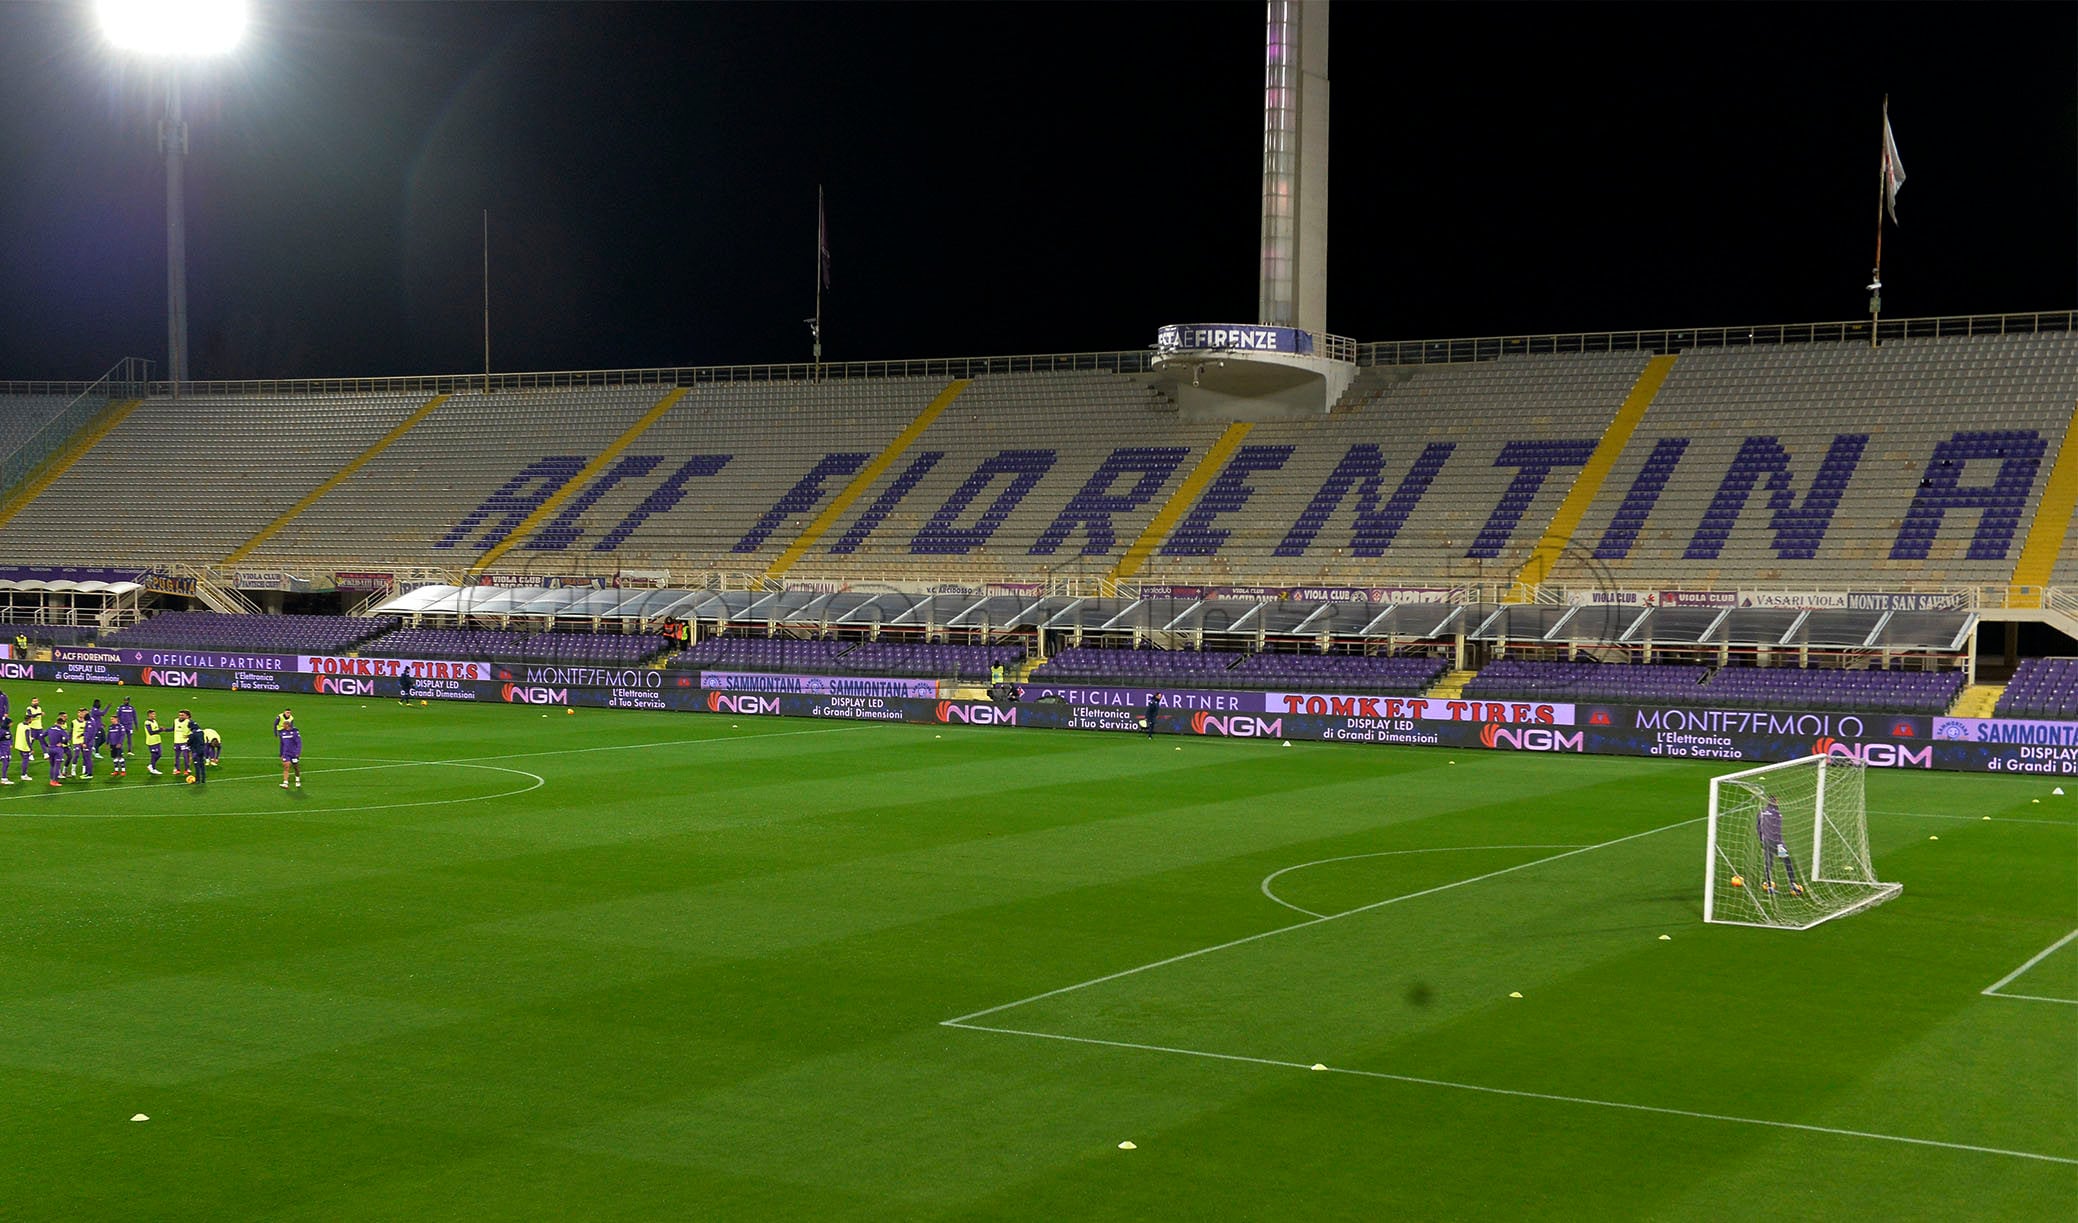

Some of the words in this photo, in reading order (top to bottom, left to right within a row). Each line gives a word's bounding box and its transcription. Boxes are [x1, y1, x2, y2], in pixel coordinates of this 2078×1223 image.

[433, 455, 734, 551] ACF
[731, 429, 2048, 558] FIORENTINA
[493, 576, 517, 584] VIOLA
[519, 577, 541, 585] CLUB
[1304, 590, 1329, 600] VIOLA
[1331, 591, 1350, 601] CLUB
[1592, 592, 1615, 603] VIOLA
[1616, 593, 1637, 604] CLUB
[1679, 593, 1707, 602] VIOLA
[1709, 594, 1735, 602] CLUB
[1756, 594, 1804, 606] VASARI
[1806, 595, 1845, 607] VIOLA
[1849, 594, 1889, 610] MONTE
[1891, 595, 1915, 611] SAN
[62, 652, 76, 661] ACF
[76, 653, 121, 663] FIORENTINA
[153, 654, 214, 668] OFFICIAL
[220, 656, 282, 670] PARTNER
[68, 664, 94, 673] DISPLAY
[95, 665, 106, 674] LED
[309, 657, 400, 676] TOMKET
[411, 662, 479, 680] TIRES
[55, 672, 62, 680] di
[63, 672, 85, 682] Grandi
[86, 673, 120, 682] Dimensioni
[149, 671, 198, 687] NGM
[415, 679, 444, 689] DISPLAY
[446, 681, 459, 689] LED
[241, 681, 253, 690] Tuo
[253, 681, 280, 690] Servizio
[322, 679, 374, 696] NGM
[726, 676, 801, 693] SAMMONTANA
[829, 681, 908, 698] SAMMONTANA
[409, 689, 434, 698] Grandi
[436, 690, 475, 699] Dimensioni
[511, 686, 567, 704] NGM
[609, 698, 617, 706] al
[619, 699, 632, 707] Tuo
[634, 699, 666, 709] Servizio
[717, 695, 780, 714] NGM
[831, 697, 865, 707] DISPLAY
[868, 698, 884, 708] LED
[1146, 693, 1239, 710] PARTNER
[812, 705, 820, 715] di
[823, 706, 854, 718] Grandi
[856, 708, 903, 719] Dimensioni
[946, 704, 1017, 726] NGM
[1284, 695, 1428, 720] TOMKET
[1446, 702, 1555, 724] TIRES
[1068, 719, 1080, 728] al
[1081, 719, 1097, 729] Tuo
[1099, 719, 1139, 730] Servizio
[1203, 715, 1282, 738] NGM
[1347, 718, 1391, 730] DISPLAY
[1394, 719, 1414, 731] LED
[1323, 728, 1334, 739] di
[1337, 729, 1375, 741] Grandi
[1378, 731, 1438, 743] Dimensioni
[1493, 728, 1584, 752] NGM
[1650, 745, 1662, 755] al
[1666, 745, 1686, 756] Tuo
[1691, 747, 1742, 759] Servizio
[1827, 742, 1933, 768] NGM
[2020, 747, 2078, 760] DISPLAY
[1988, 758, 2001, 770] di
[2006, 759, 2057, 772] Grandi
